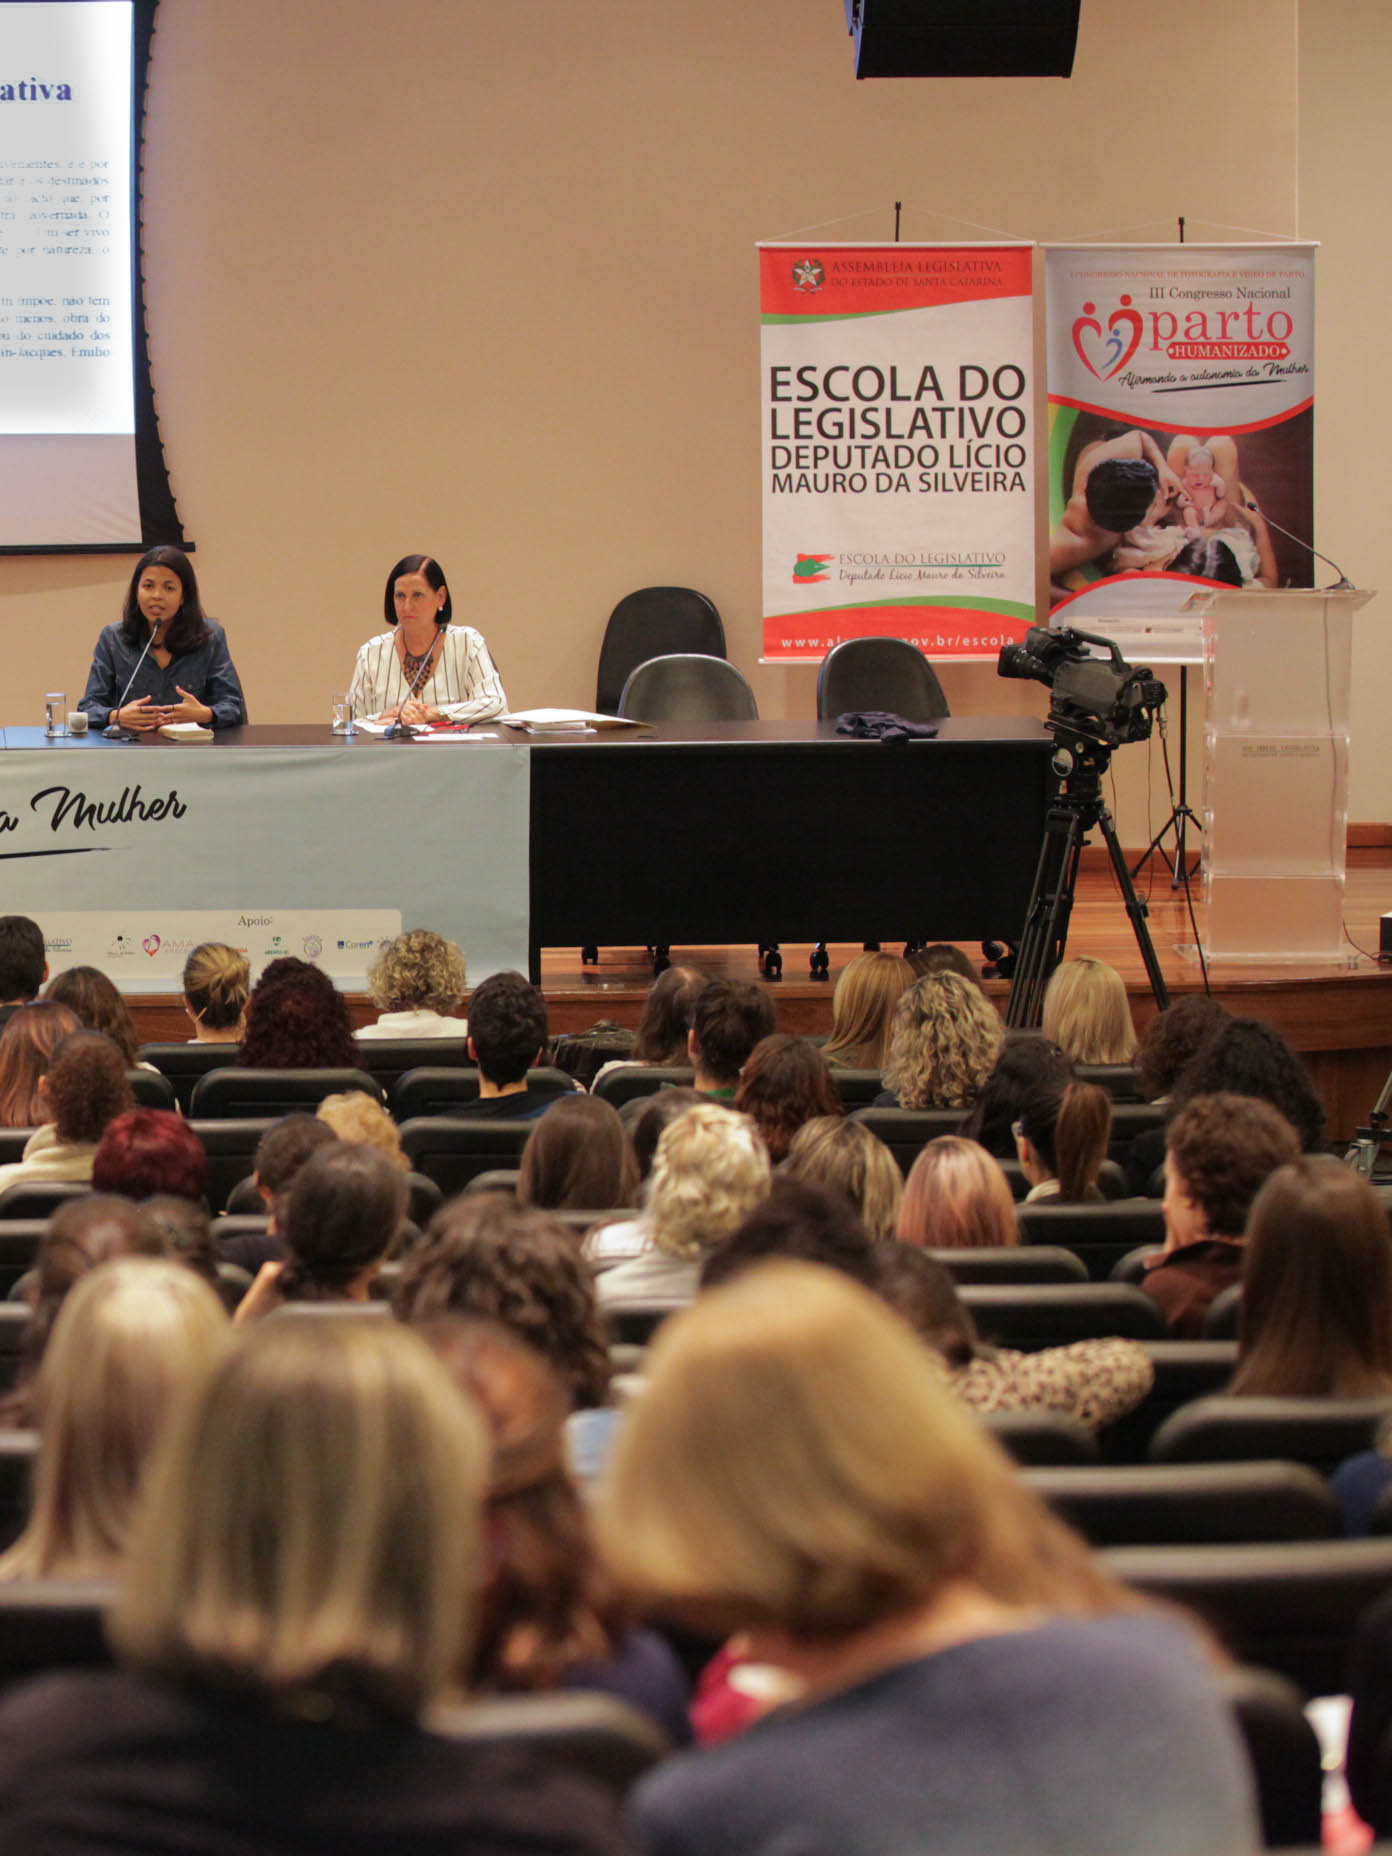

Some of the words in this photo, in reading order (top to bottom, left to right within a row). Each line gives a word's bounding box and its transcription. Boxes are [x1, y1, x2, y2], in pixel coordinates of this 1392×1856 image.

[1149, 287, 1164, 299] III
[1169, 286, 1233, 301] Congresso
[1236, 286, 1292, 299] Nacional
[1148, 301, 1294, 352] parto
[1175, 344, 1281, 358] HUMANIZADO
[770, 365, 944, 402] ESCOLA
[959, 364, 1026, 401] DO
[1118, 371, 1177, 390] Afirmando
[1245, 365, 1260, 377] da
[1262, 361, 1309, 377] Mulher
[770, 406, 1026, 440] LEGISLATIVO
[771, 444, 939, 470] DEPUTADO
[949, 438, 1027, 470] LÍCIO
[772, 472, 868, 493] MAURO
[875, 472, 911, 493] DA
[919, 471, 1026, 493] SILVEIRA
[839, 553, 889, 565] ESCOLA
[894, 552, 916, 564] DO
[920, 552, 1006, 564] LEGISLATIVO
[29, 784, 188, 832] Mulher
